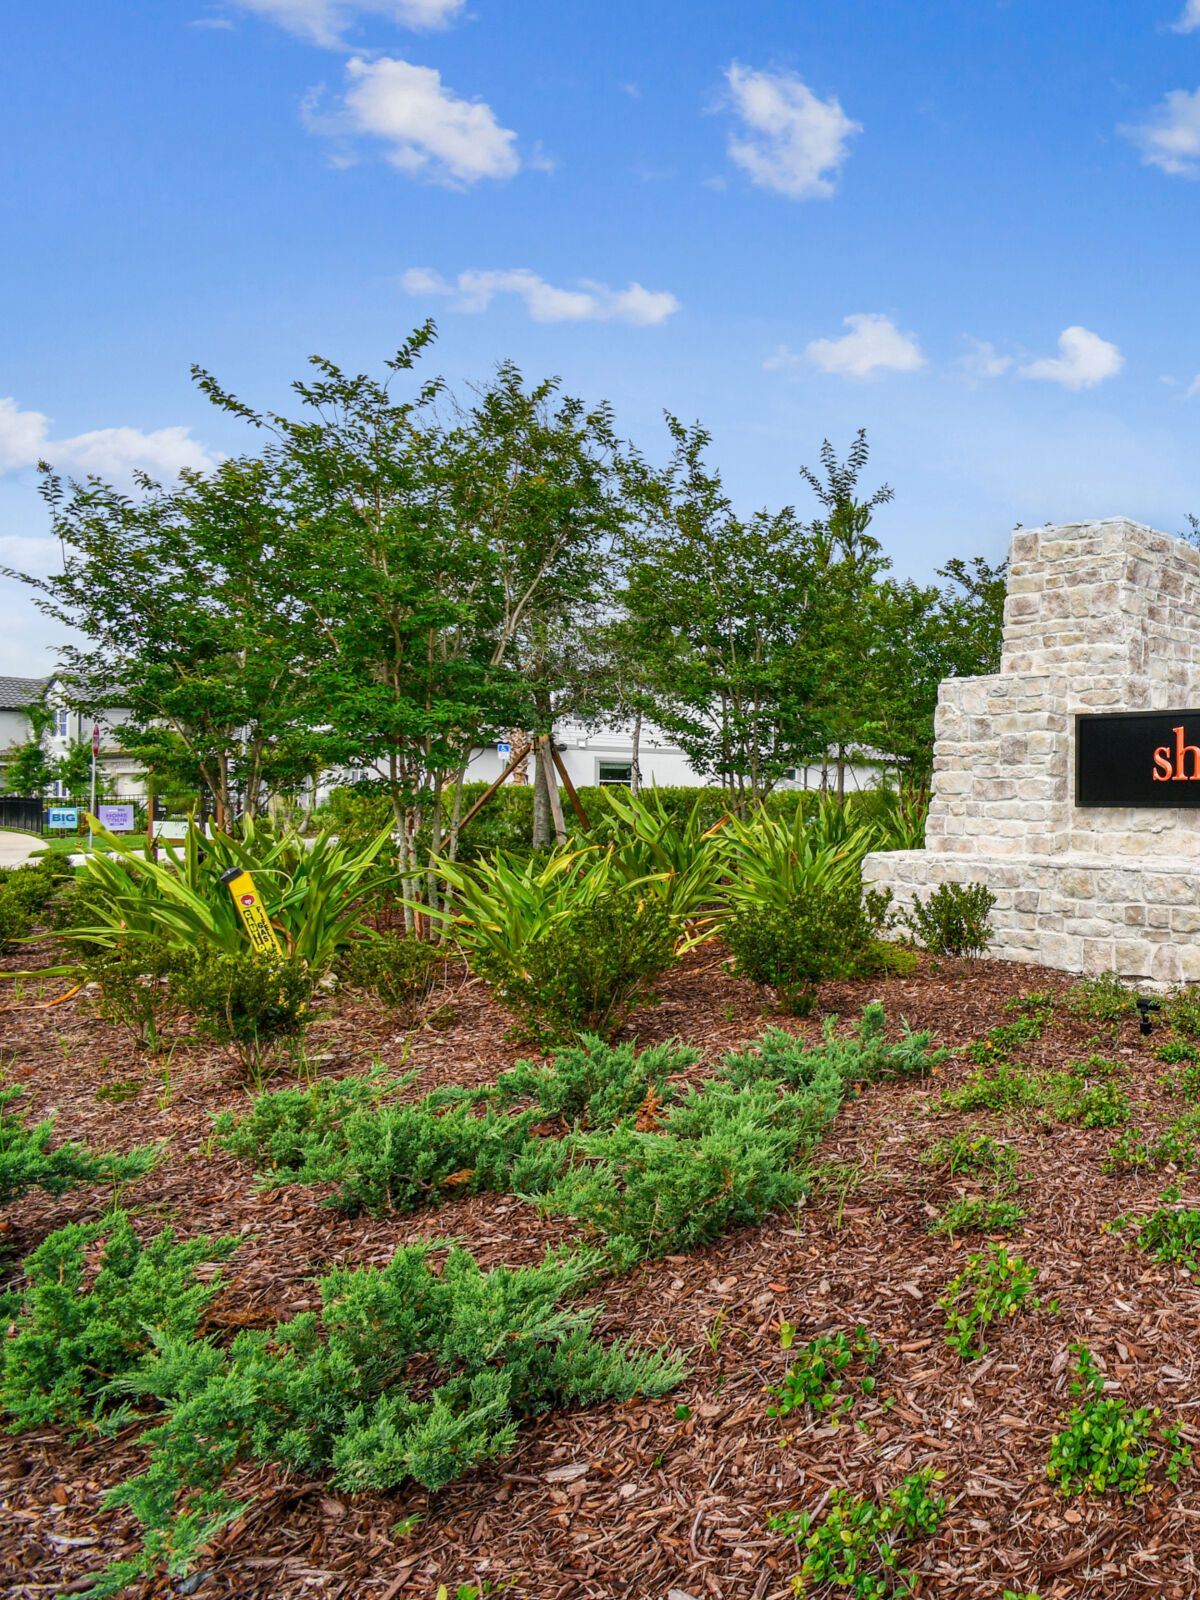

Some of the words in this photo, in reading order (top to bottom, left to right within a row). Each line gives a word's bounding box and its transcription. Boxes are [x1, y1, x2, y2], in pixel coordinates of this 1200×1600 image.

[52, 814, 76, 822] BIG
[243, 910, 265, 952] CAUTIO
[257, 922, 269, 943] GAS
